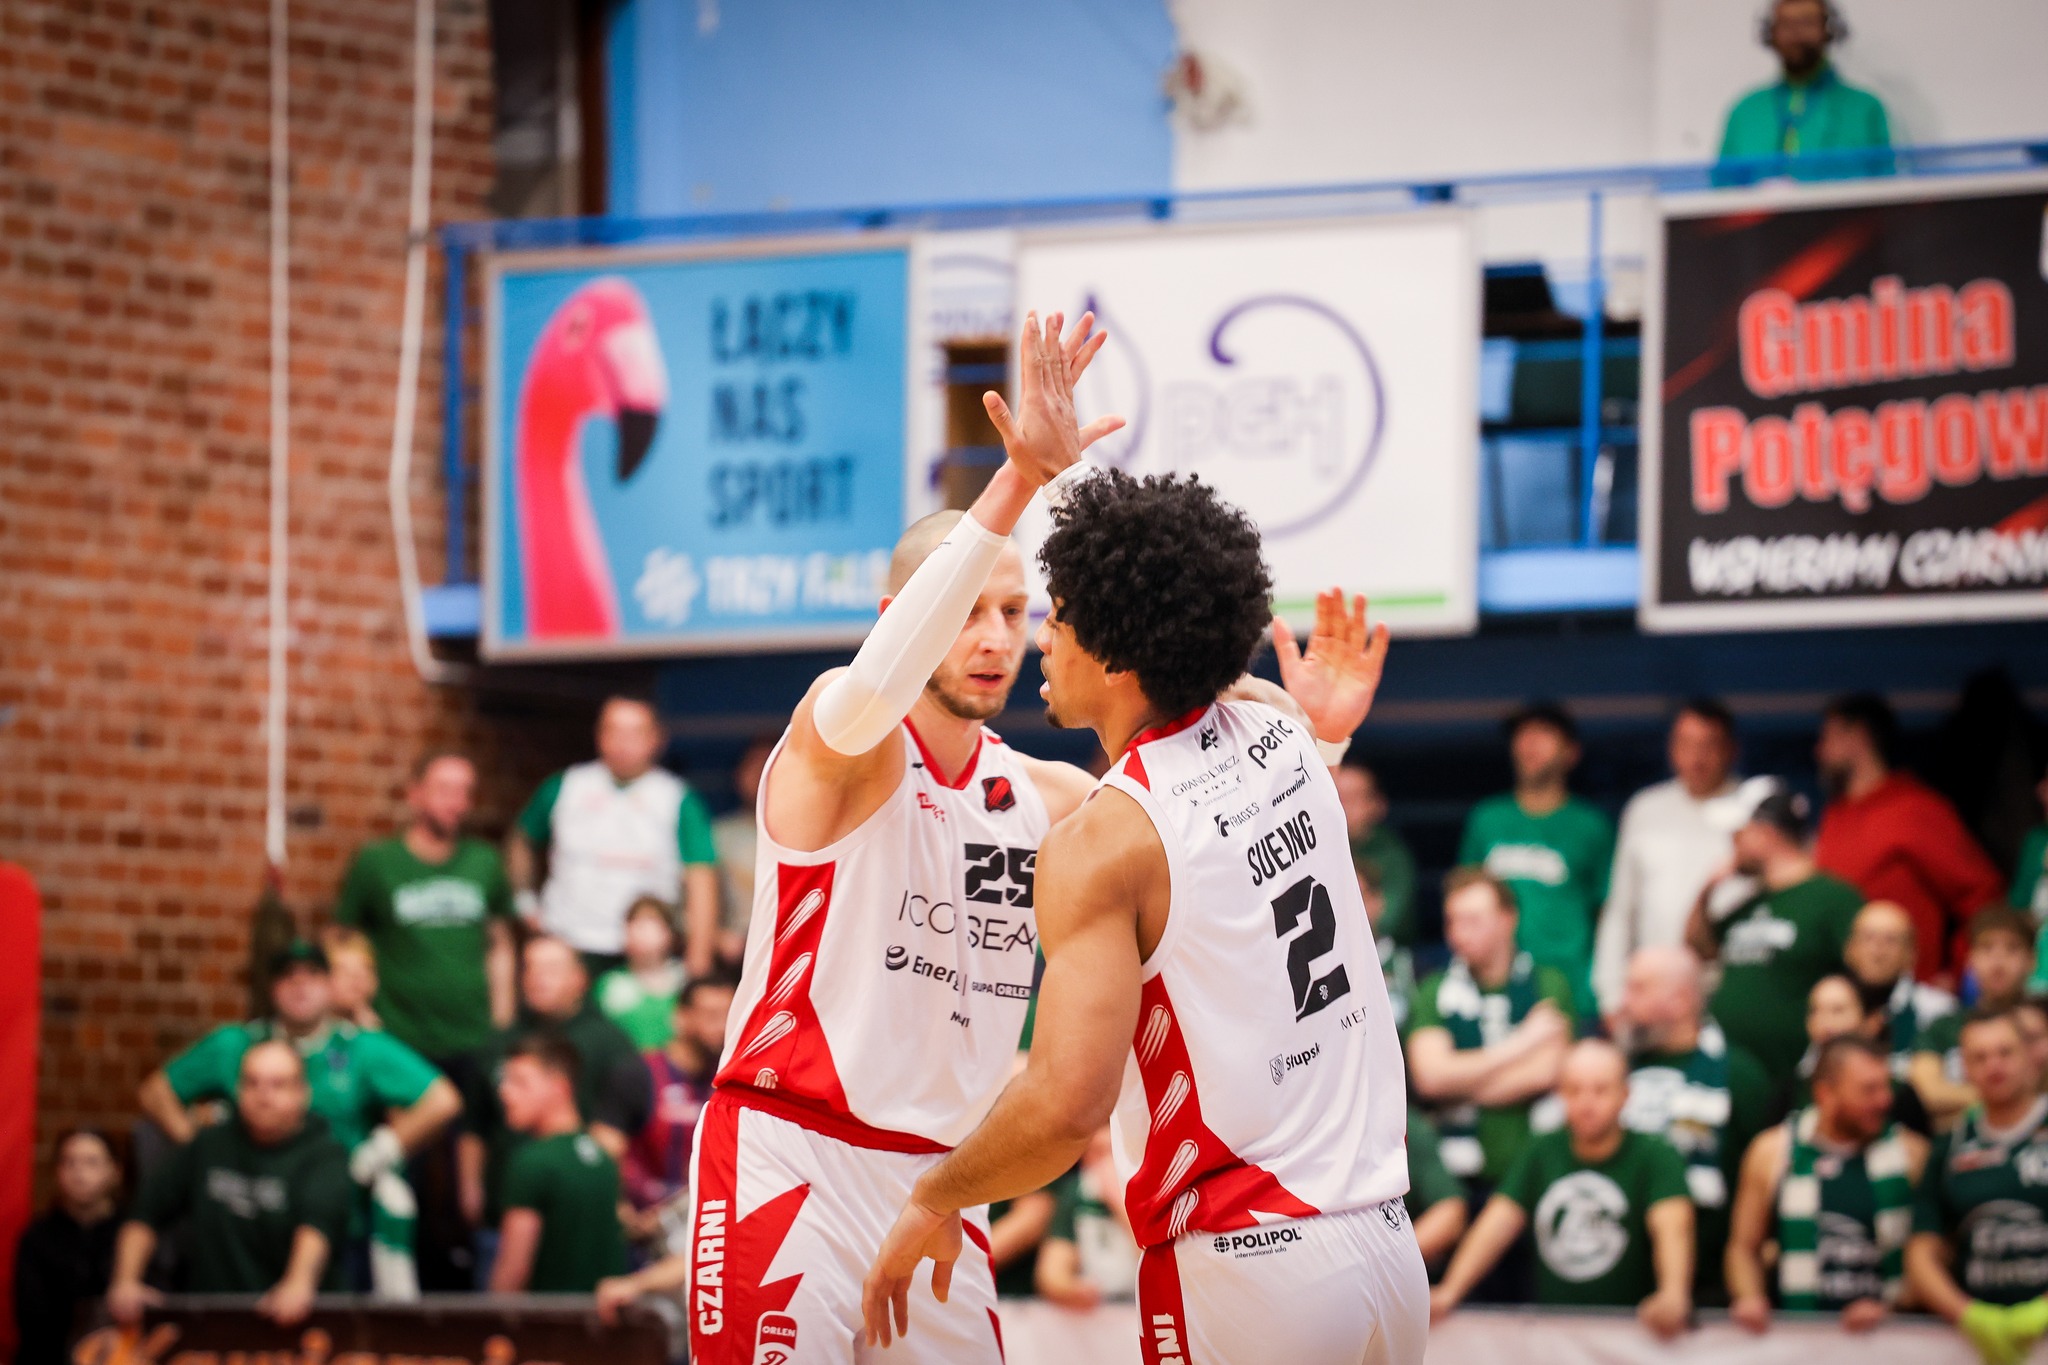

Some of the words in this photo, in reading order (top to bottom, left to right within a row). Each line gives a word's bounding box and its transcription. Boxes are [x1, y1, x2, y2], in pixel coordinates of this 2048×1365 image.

[1739, 275, 2014, 398] Gmina
[708, 376, 805, 443] NAS
[964, 842, 1037, 909] 25
[1247, 810, 1317, 887] SUEING
[1271, 875, 1350, 1023] 2
[697, 1199, 726, 1335] CZARNI
[1231, 1228, 1302, 1251] POLIPOL
[762, 1325, 796, 1338] ORLEN
